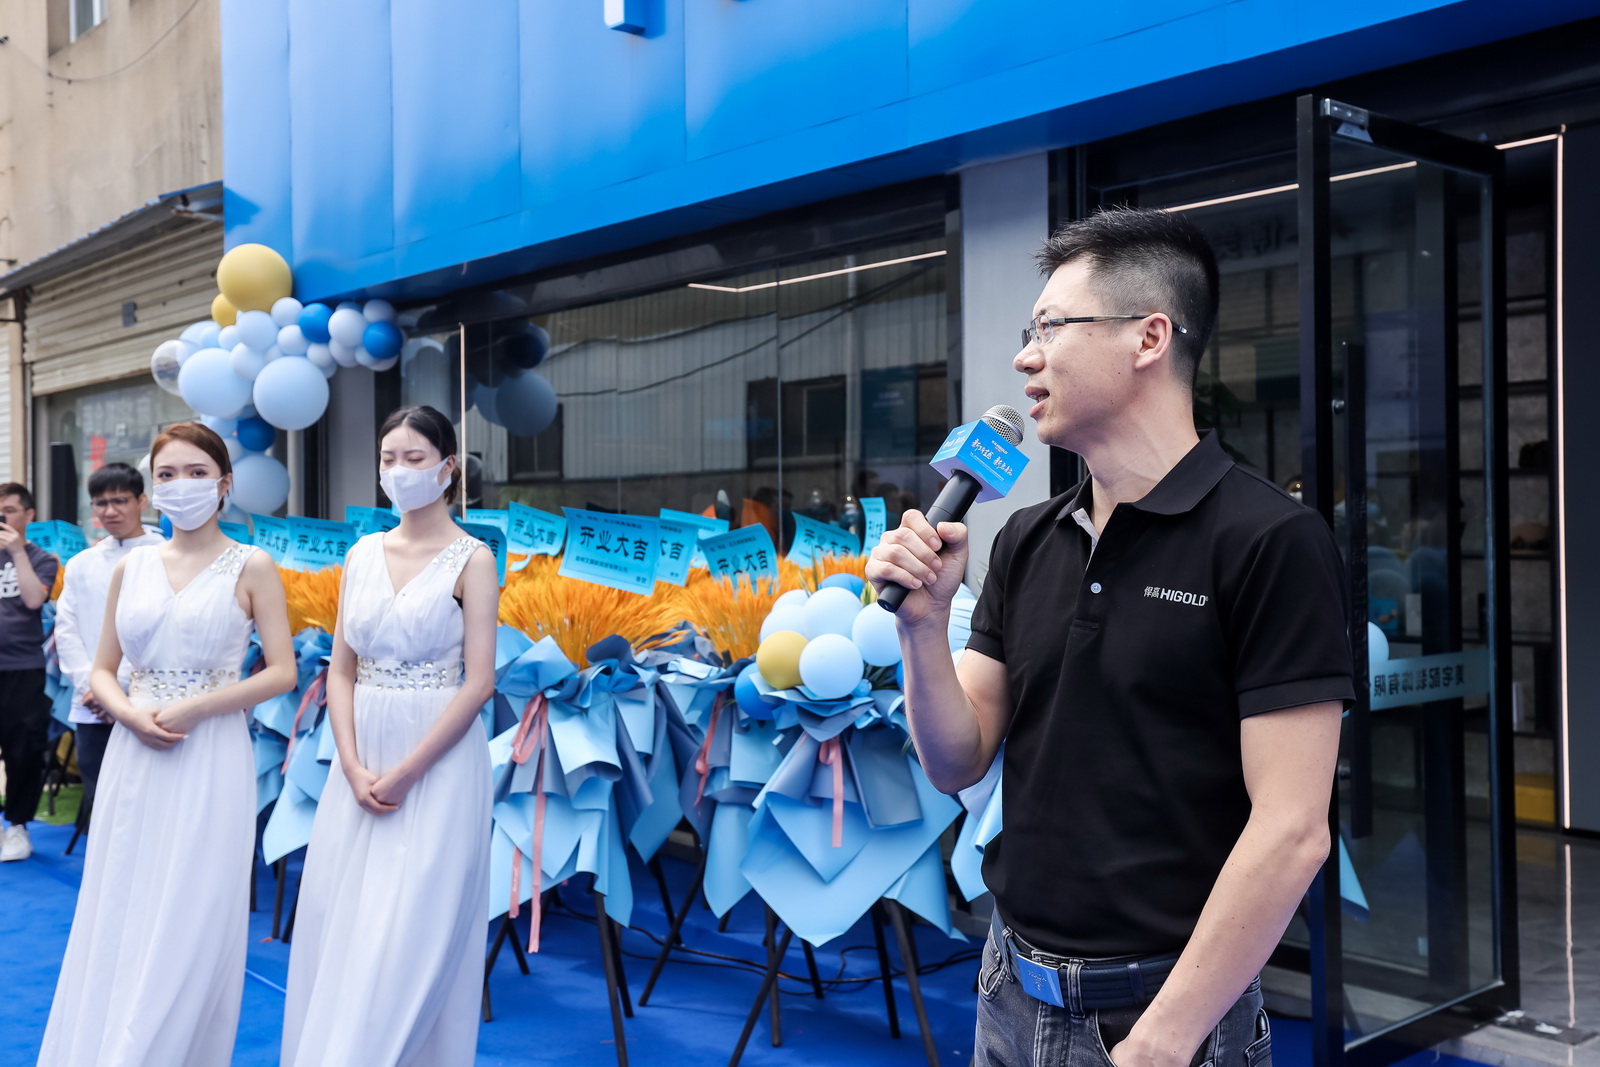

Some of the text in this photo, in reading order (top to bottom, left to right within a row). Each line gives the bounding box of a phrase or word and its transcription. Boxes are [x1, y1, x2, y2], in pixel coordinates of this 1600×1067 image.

[258, 528, 289, 553] 开业大吉
[514, 519, 557, 545] 开业大吉
[580, 526, 648, 561] 开业大吉
[297, 534, 348, 558] 开业大吉
[717, 549, 768, 575] 开业大吉
